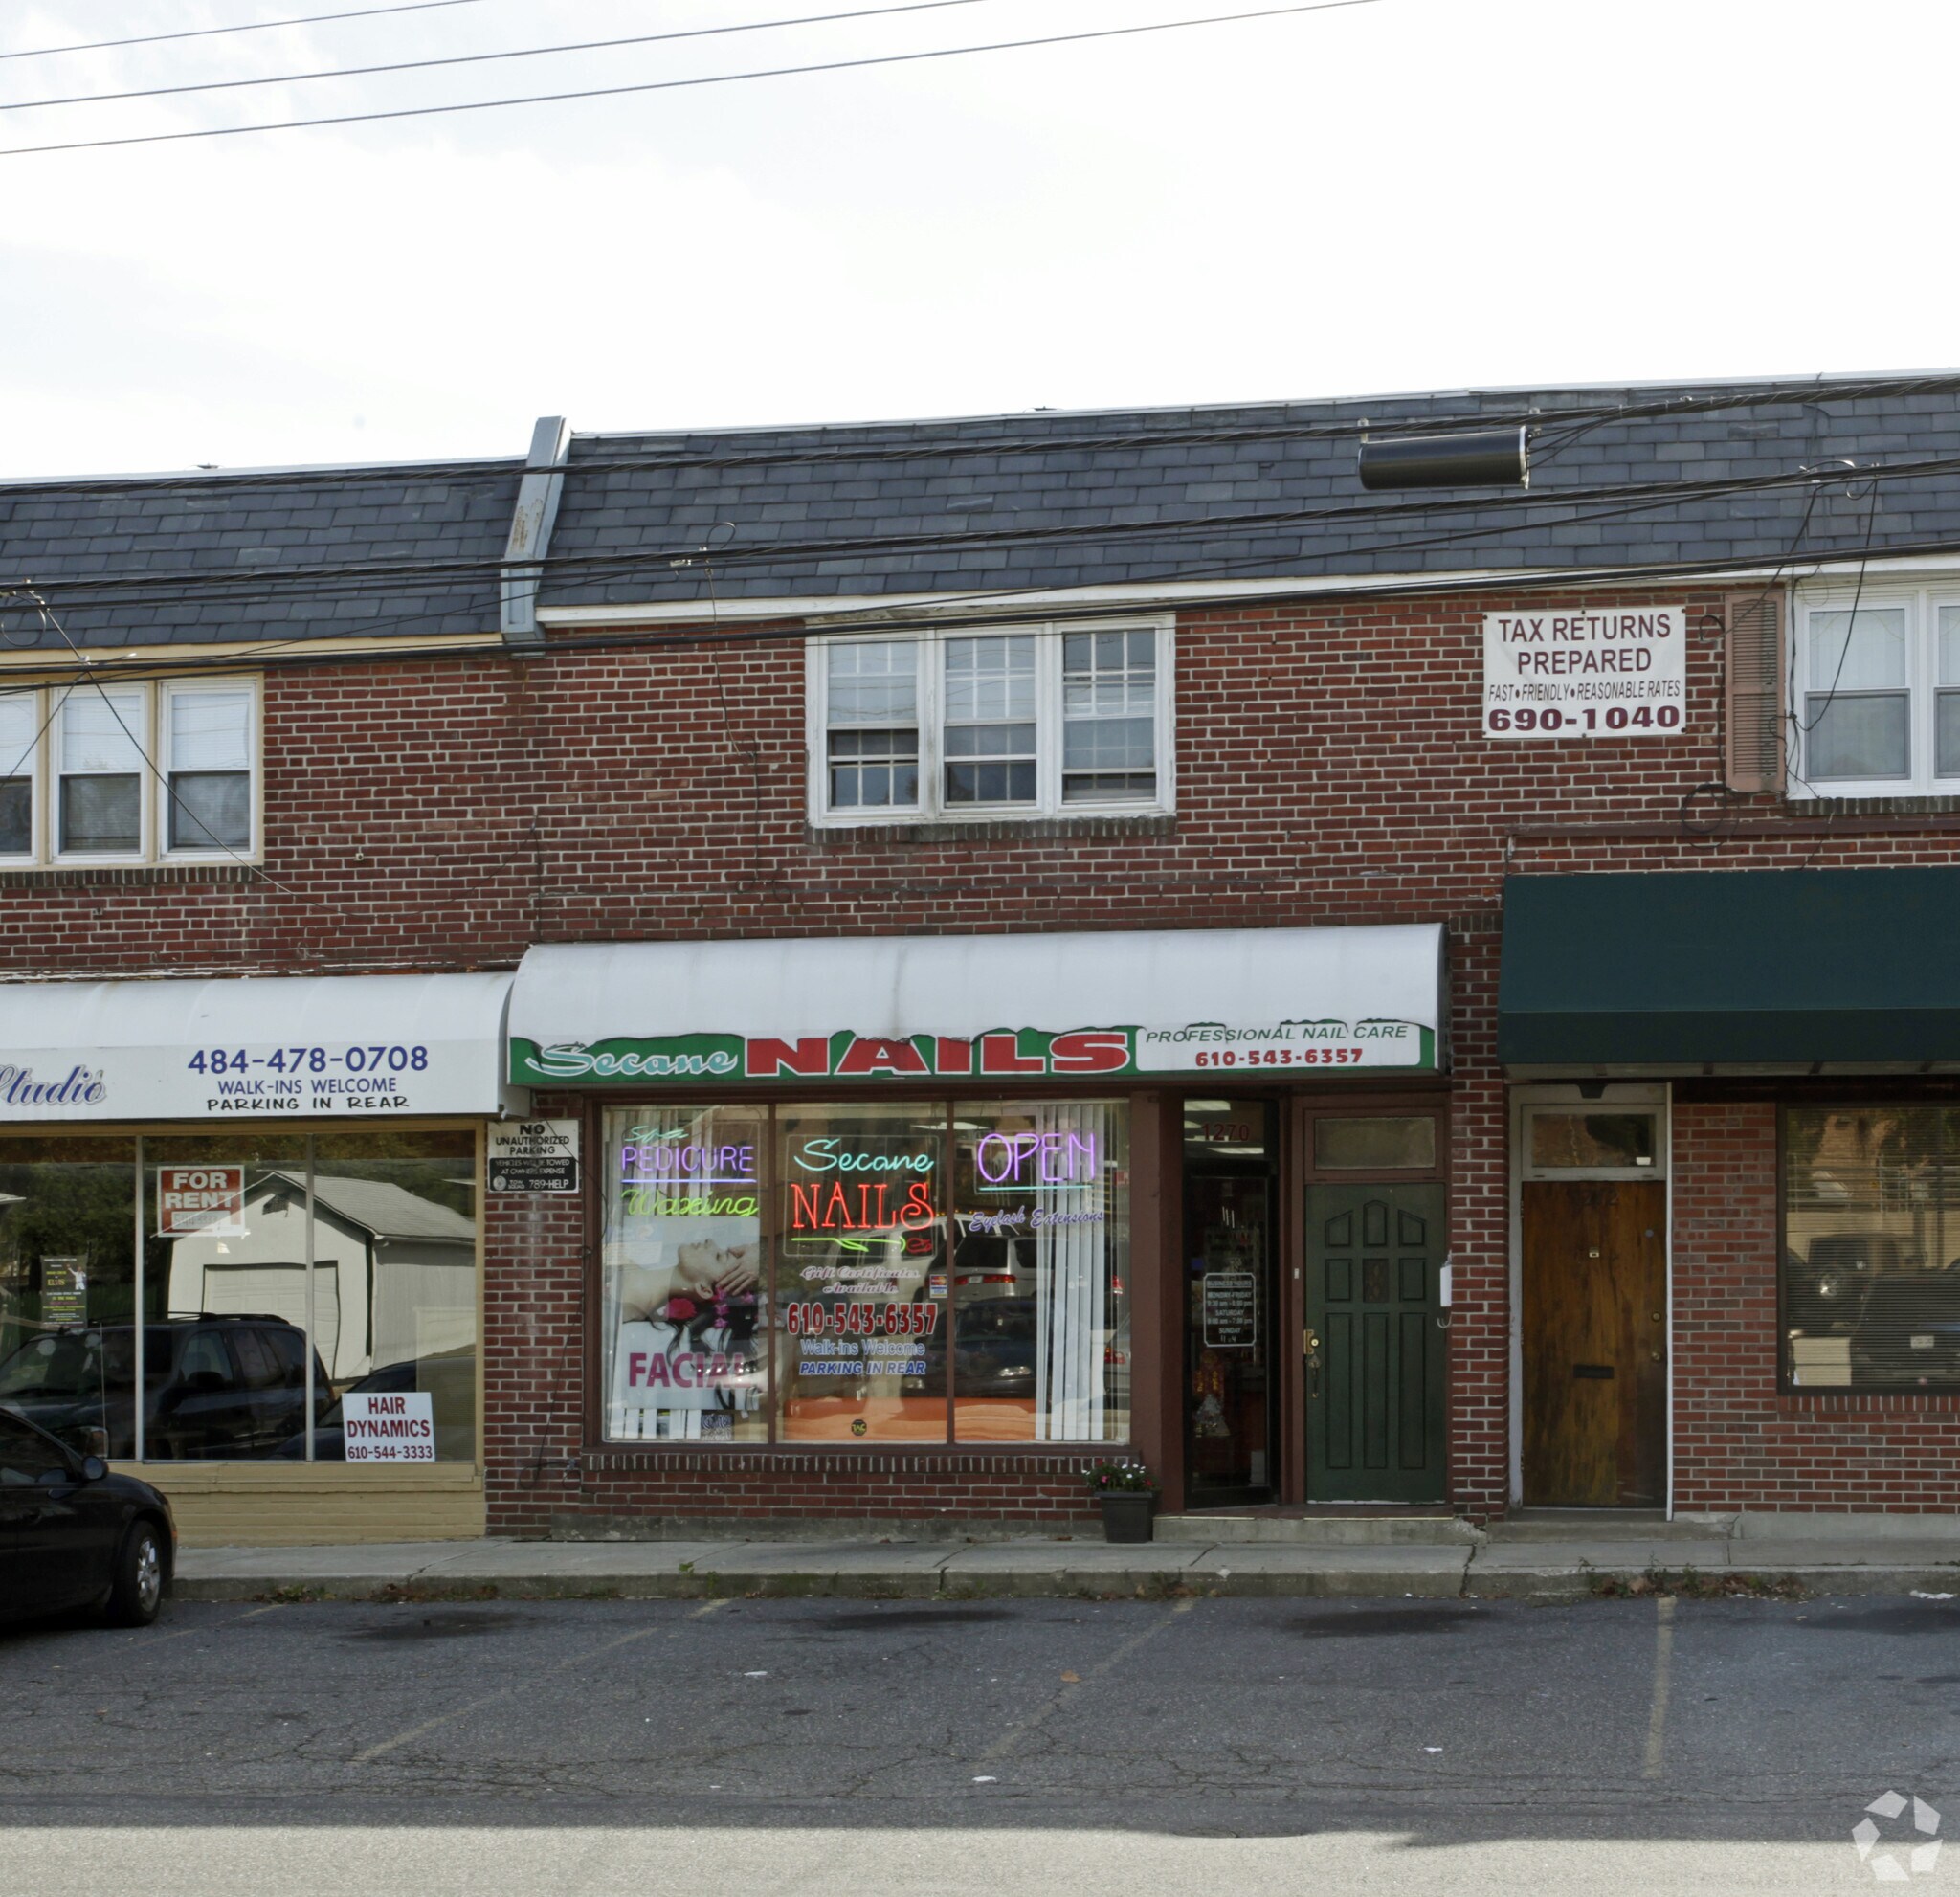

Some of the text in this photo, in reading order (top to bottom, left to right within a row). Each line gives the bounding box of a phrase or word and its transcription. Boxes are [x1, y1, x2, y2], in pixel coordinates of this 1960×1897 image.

[1498, 614, 1671, 642] TAX RETURNS
[1518, 647, 1652, 675] PREPARED
[1488, 680, 1681, 701] FAST FRIENDLY REASONABLE RATES
[1488, 705, 1680, 731] 690-1040
[1146, 1024, 1409, 1043] PROFESSIONAL NAIL CARE
[188, 1045, 429, 1074] 484-478-0708
[525, 1031, 1129, 1077] Secane NAILS
[1195, 1048, 1363, 1067] 610-543-6357
[218, 1077, 397, 1095] WALK-INS WELCOME
[207, 1095, 410, 1111] PARKING IN REAR
[520, 1124, 545, 1135] NO
[1201, 1123, 1250, 1142] 1270
[495, 1136, 569, 1146] UNAUTHORIZED
[509, 1146, 555, 1155] PARKING
[622, 1146, 755, 1172] PEDICURE
[793, 1137, 935, 1172] Secane
[977, 1133, 1096, 1183] OPEN
[172, 1172, 228, 1189] FOR
[165, 1191, 237, 1209] RENT
[621, 1189, 760, 1217] Waxing
[791, 1181, 935, 1231] NAILS
[969, 1205, 1105, 1233] Eyelash Extensions
[787, 1302, 939, 1335] 610-543-6357
[800, 1339, 926, 1356] Walk-ins Welcome
[629, 1351, 753, 1388] FACIAL
[799, 1360, 926, 1375] PARKING IN REAR
[368, 1396, 406, 1415] HAIR
[346, 1419, 431, 1438] DYNAMICS
[347, 1445, 433, 1460] 610-544-3333
